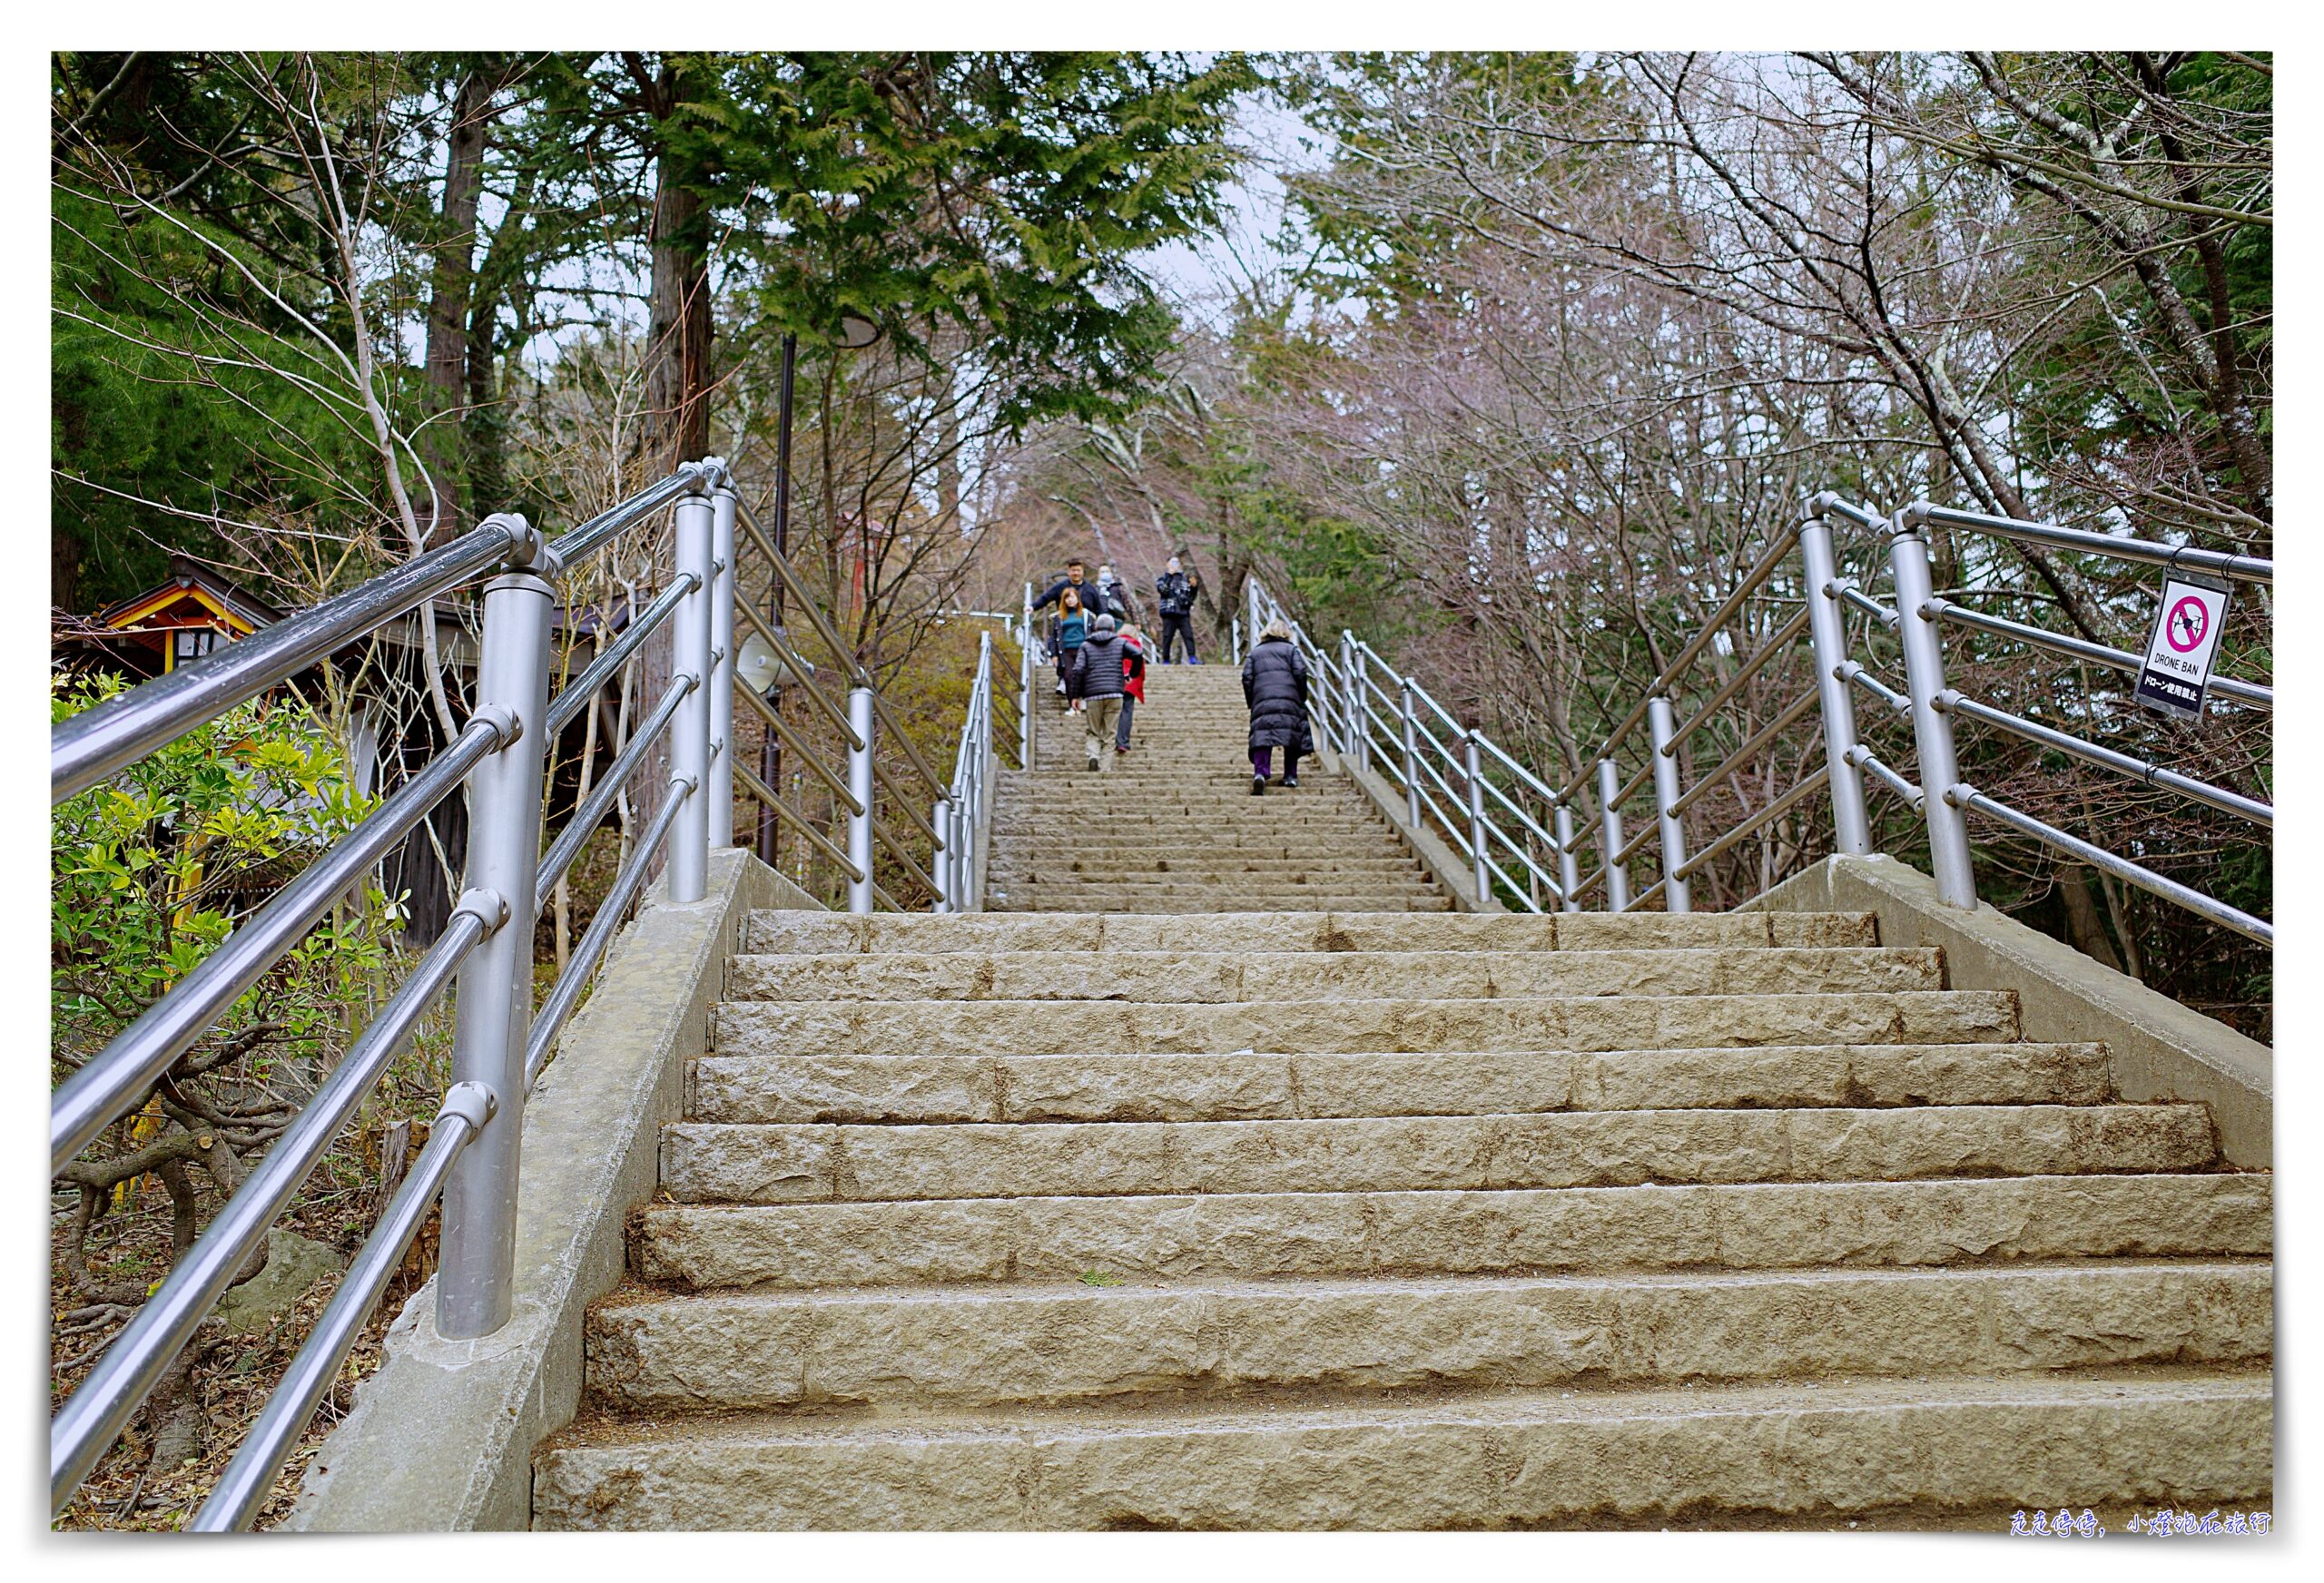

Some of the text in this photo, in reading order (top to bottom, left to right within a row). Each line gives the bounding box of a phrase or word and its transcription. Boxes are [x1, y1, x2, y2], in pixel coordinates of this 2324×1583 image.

[2154, 653, 2200, 675] DRONE BAN
[2144, 674, 2198, 702] ドローン使用禁止
